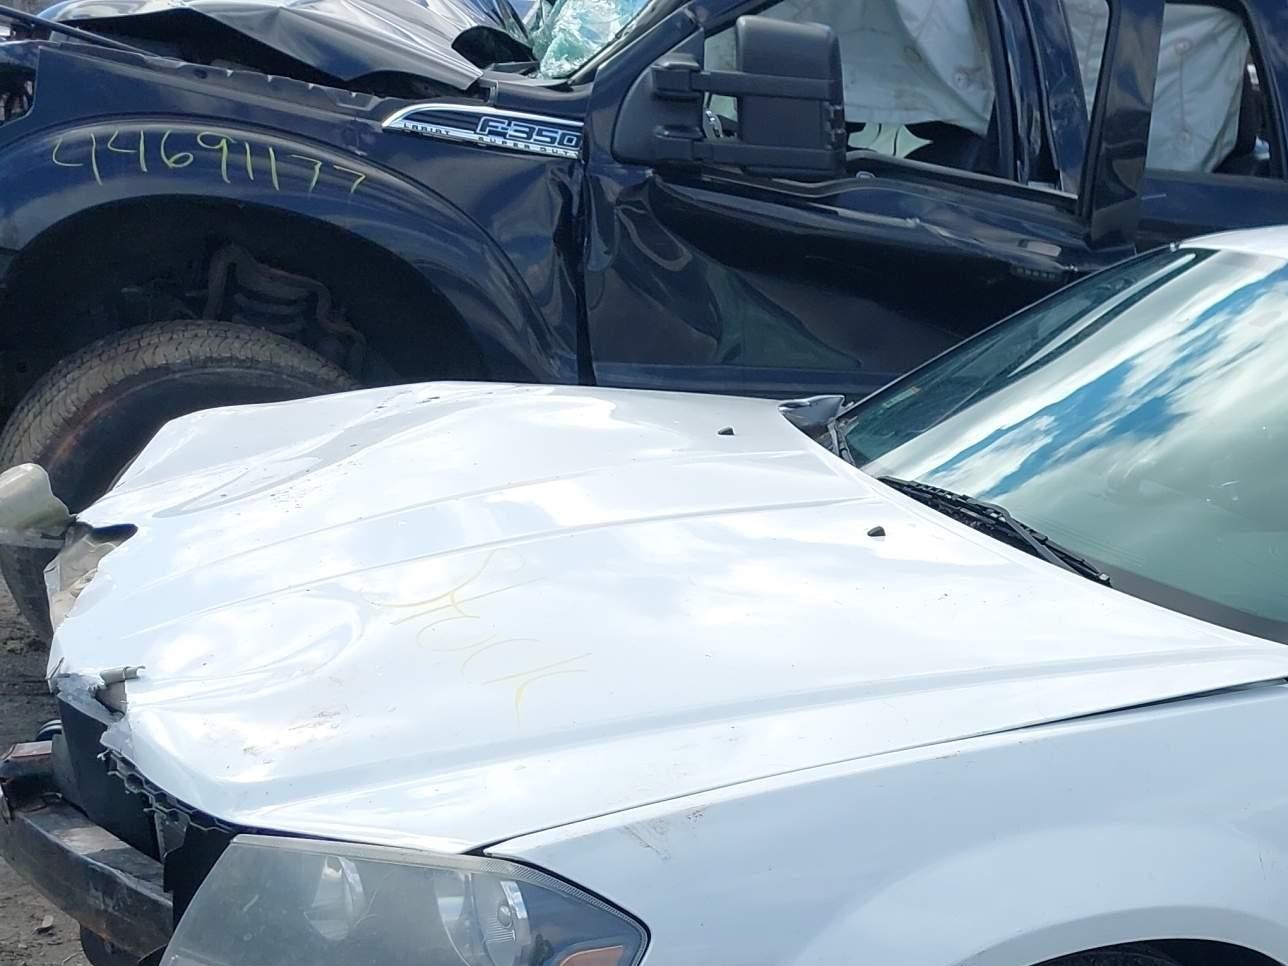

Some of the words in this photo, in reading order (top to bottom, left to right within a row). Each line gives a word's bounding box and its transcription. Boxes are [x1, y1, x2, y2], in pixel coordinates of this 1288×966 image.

[403, 122, 450, 136] LARIAT
[477, 116, 583, 149] F-350
[479, 137, 530, 151] SUPER
[538, 146, 581, 159] DUTY
